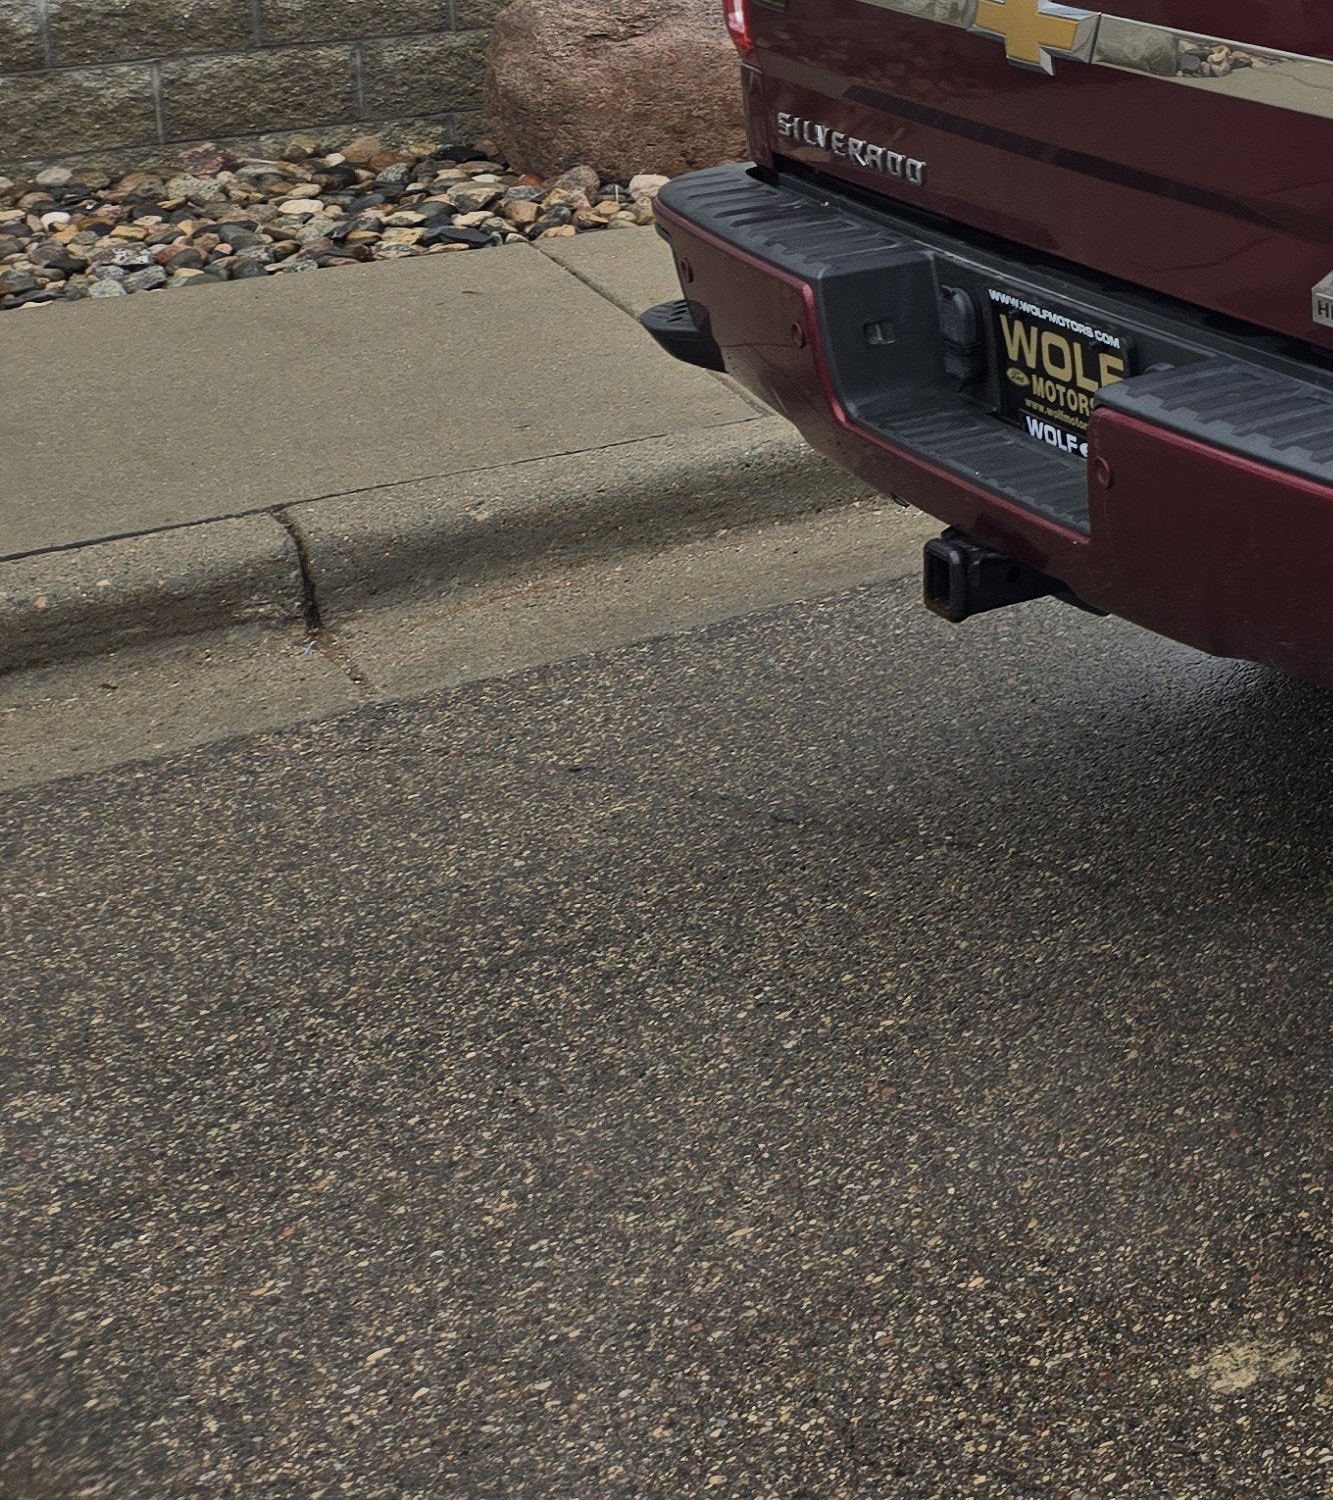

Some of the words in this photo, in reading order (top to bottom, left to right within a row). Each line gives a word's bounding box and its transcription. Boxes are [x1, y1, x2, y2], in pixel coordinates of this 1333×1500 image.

[777, 111, 928, 187] SILVERADO
[1000, 313, 1124, 393] WOLF
[1026, 415, 1079, 454] WOLF
